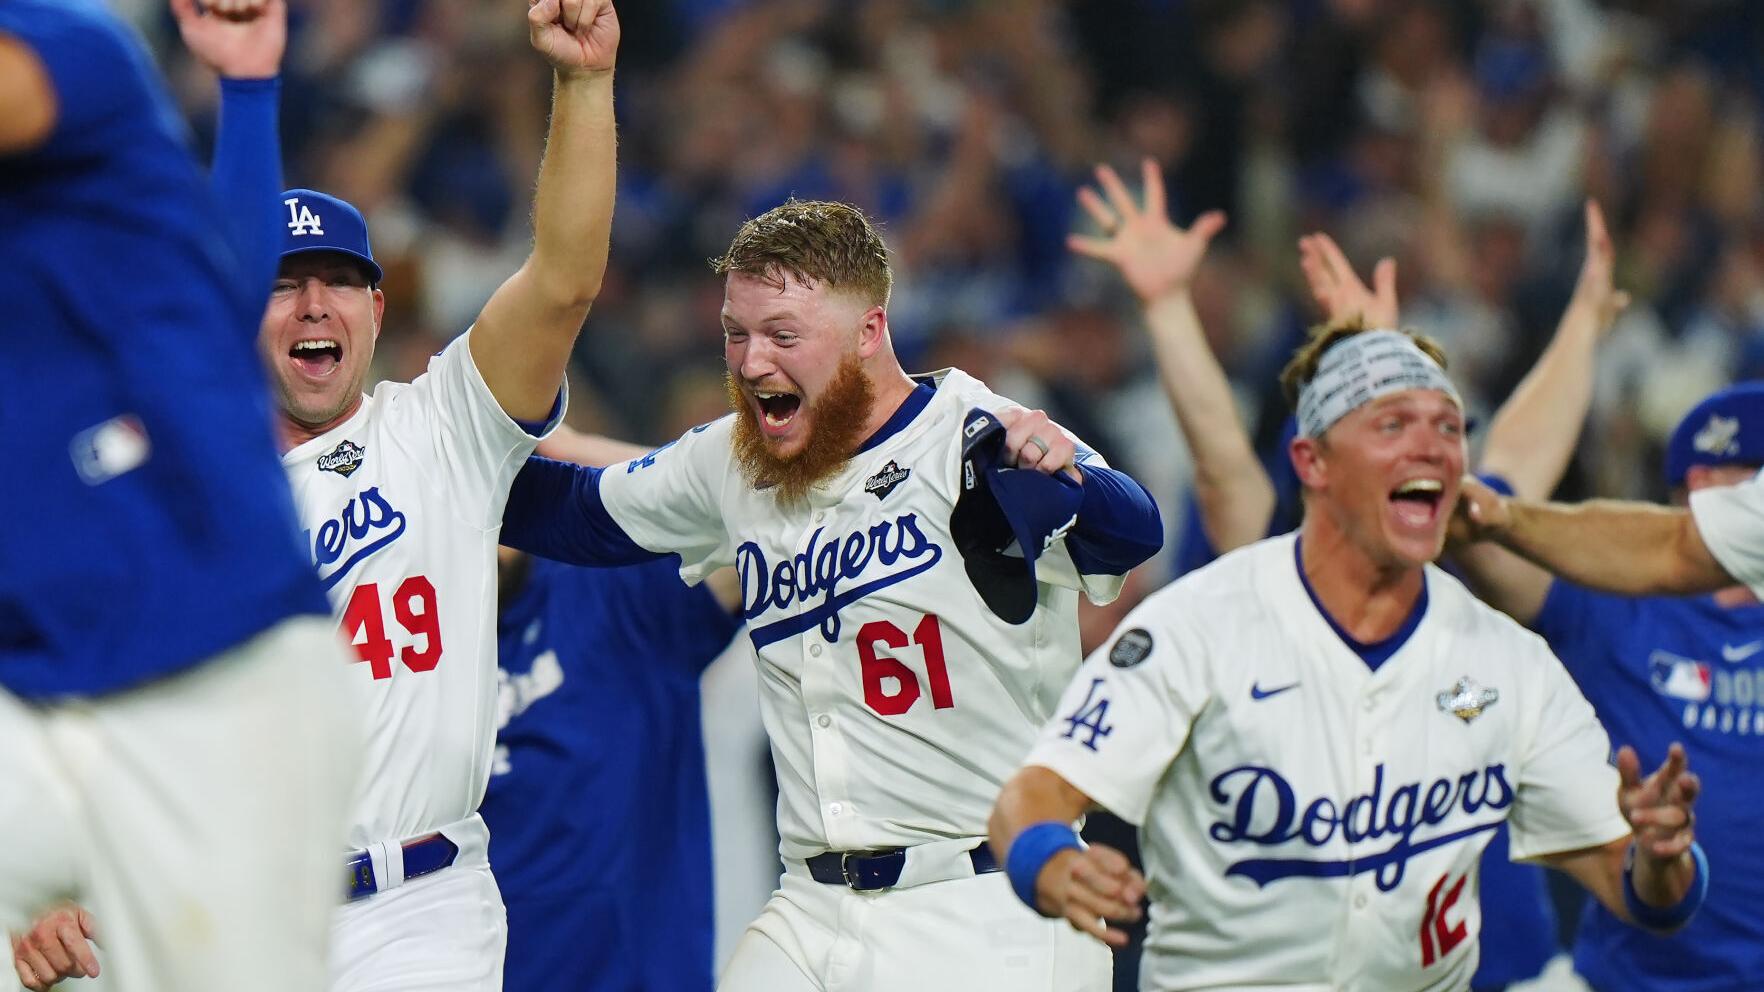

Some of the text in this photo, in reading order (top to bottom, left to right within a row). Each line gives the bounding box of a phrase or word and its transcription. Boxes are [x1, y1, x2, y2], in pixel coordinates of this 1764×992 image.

[285, 198, 324, 236] LA
[340, 575, 443, 681] 49
[735, 513, 943, 652] Dodgers
[855, 613, 955, 716] 61
[1062, 678, 1112, 752] LA
[1209, 763, 1515, 892] Dodgers
